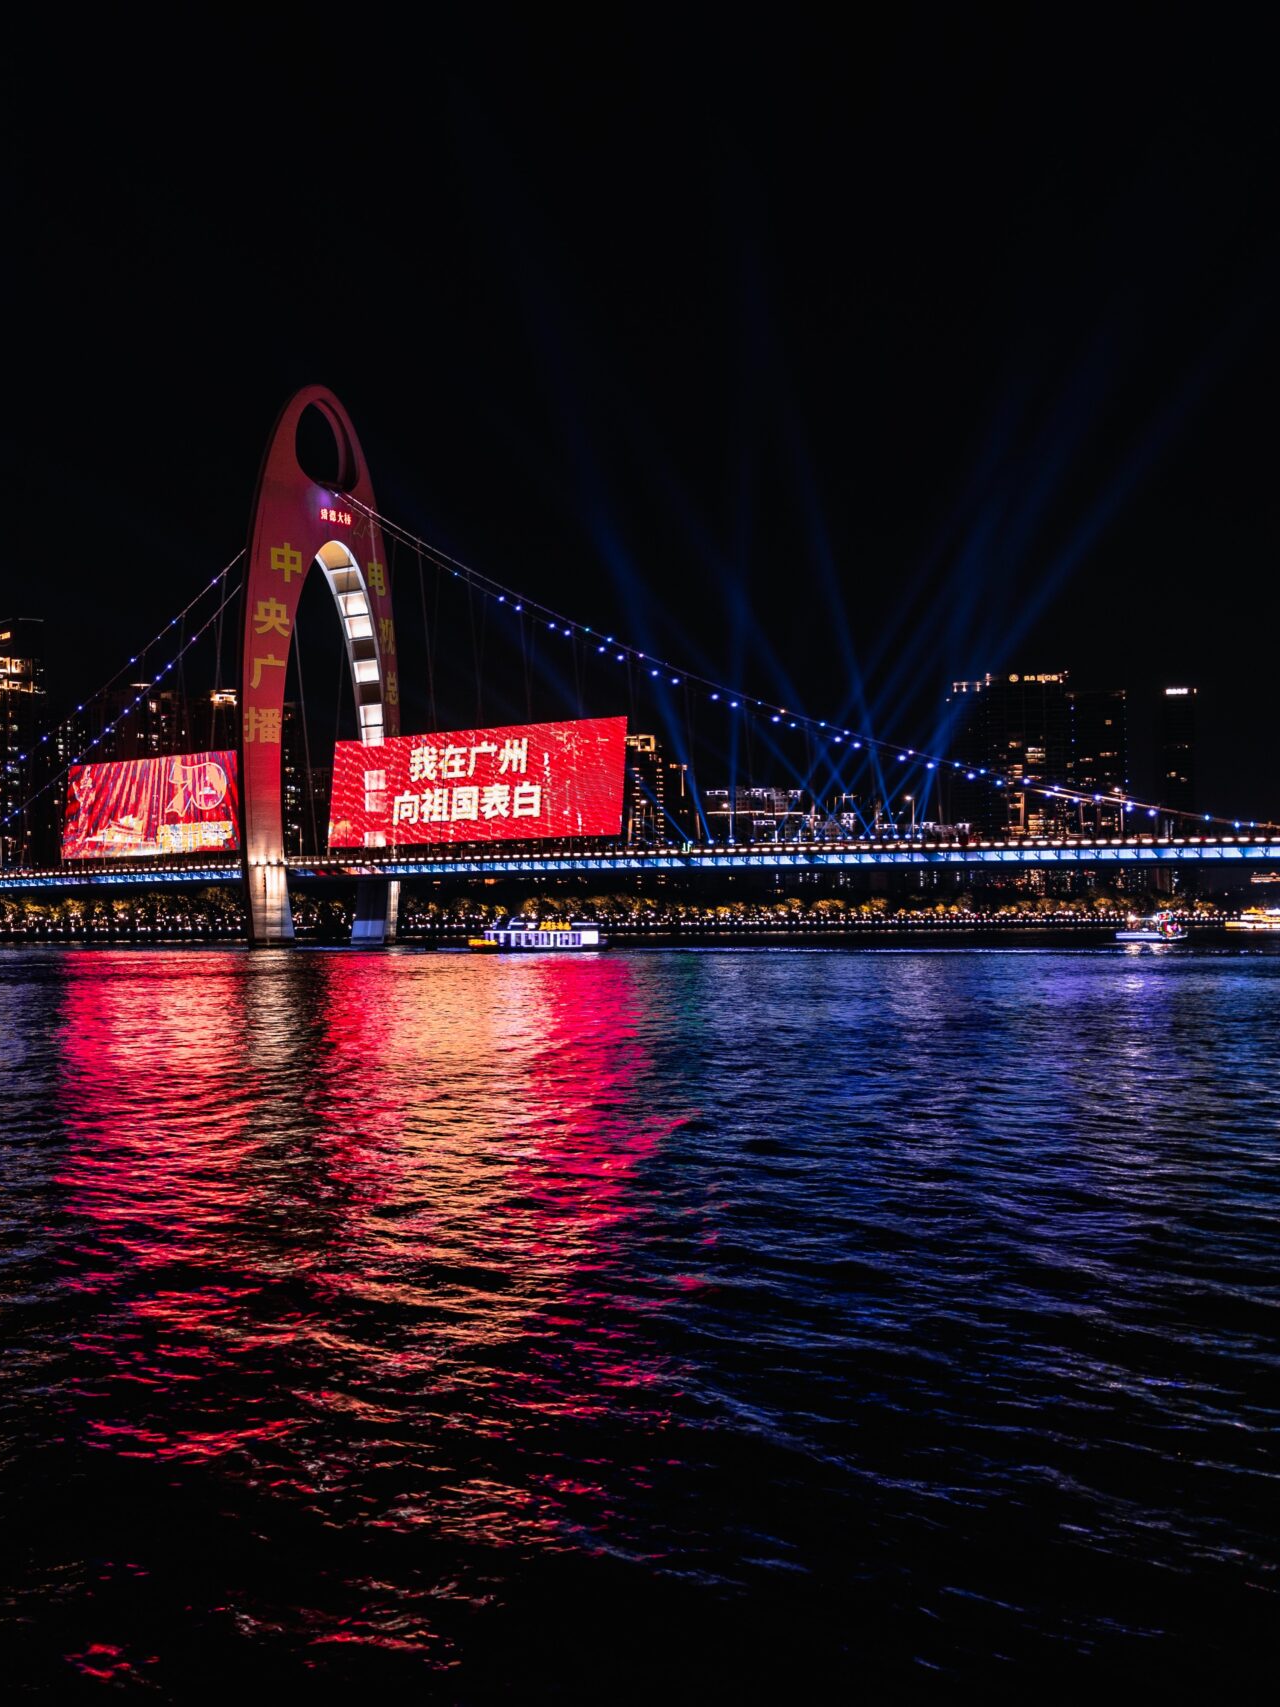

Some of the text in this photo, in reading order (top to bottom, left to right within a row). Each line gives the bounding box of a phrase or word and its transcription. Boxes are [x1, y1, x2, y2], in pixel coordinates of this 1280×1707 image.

[243, 542, 303, 744] 中央广播
[409, 738, 528, 782] 我在广州
[392, 781, 542, 826] 向祖国表白
